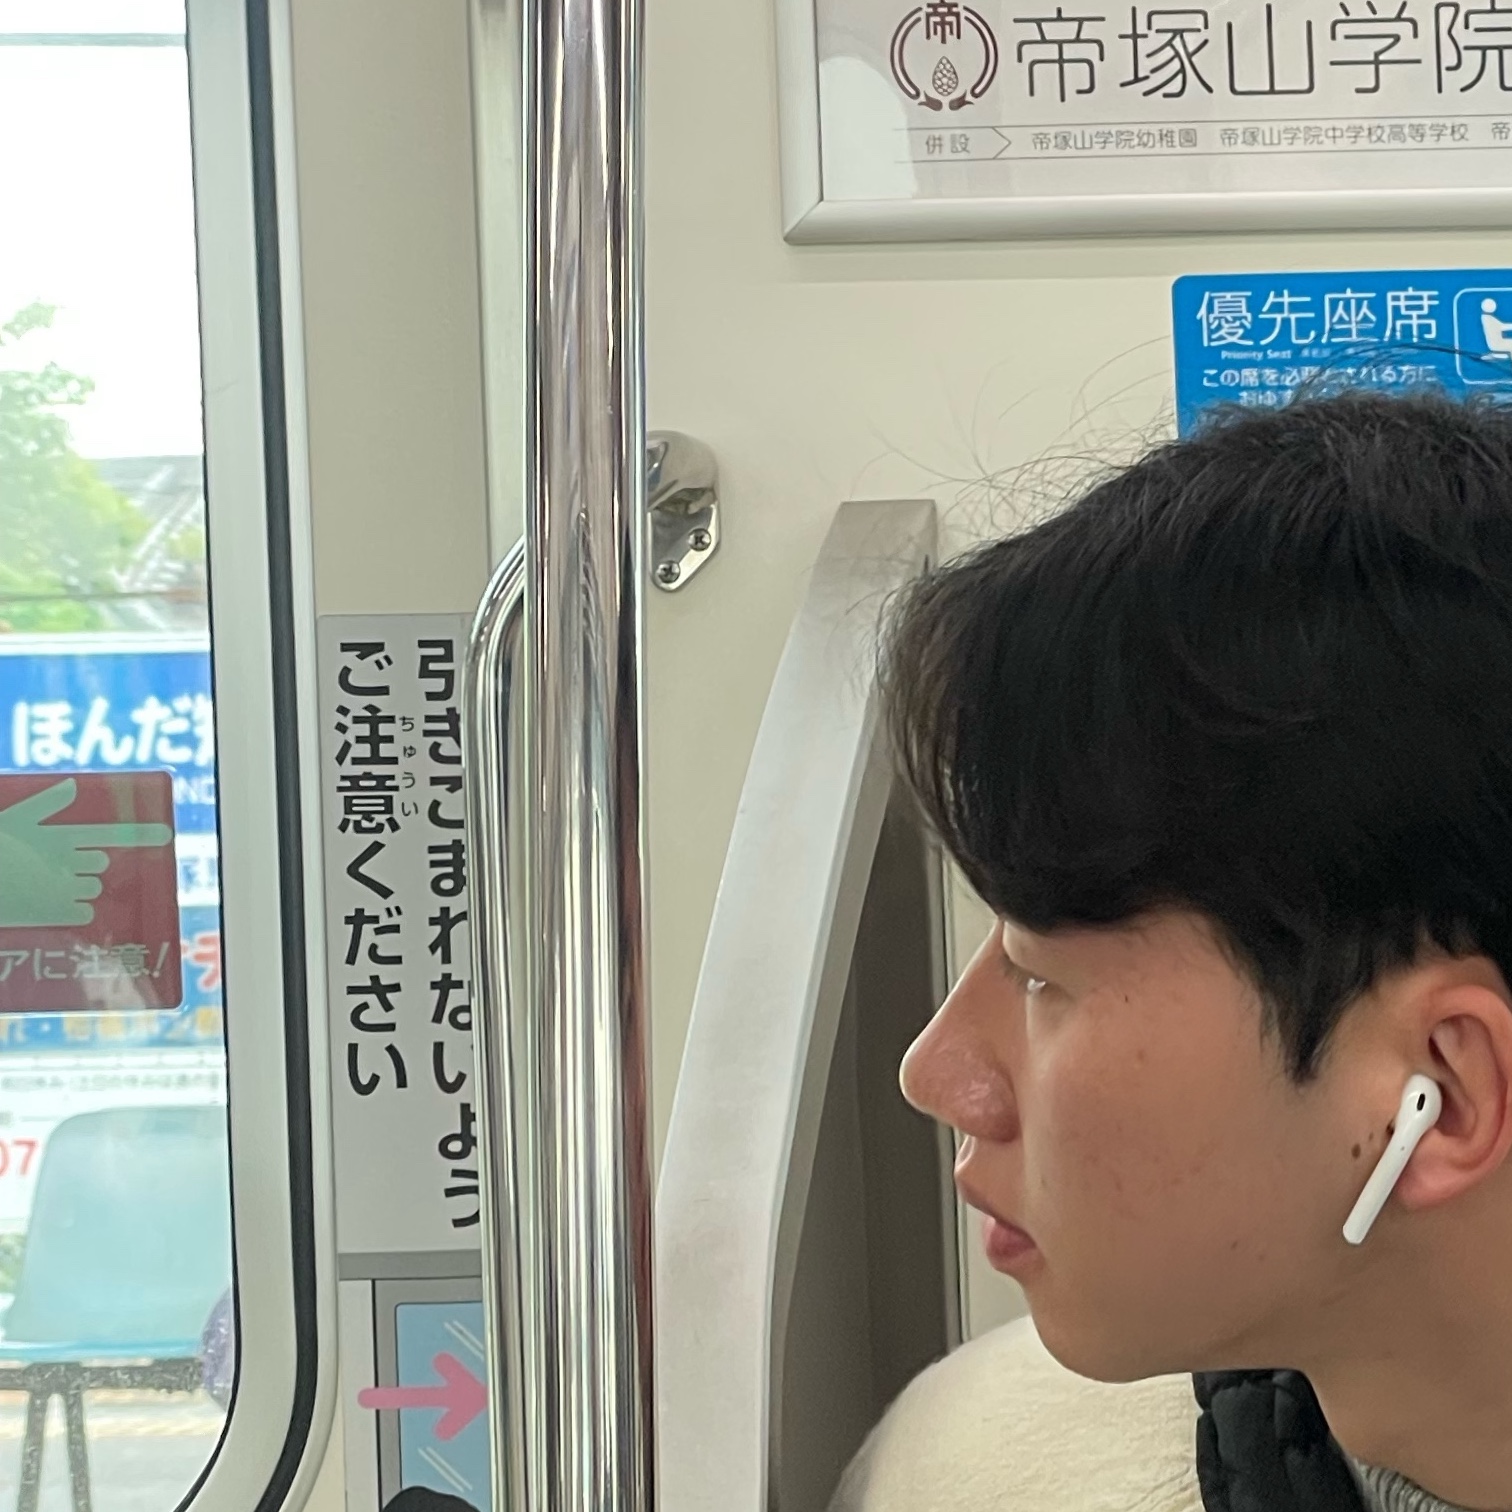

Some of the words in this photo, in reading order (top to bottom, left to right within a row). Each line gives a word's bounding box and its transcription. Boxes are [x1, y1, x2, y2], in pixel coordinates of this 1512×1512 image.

[1031, 128, 1198, 152] 帝塚山学院幼稚園
[1219, 122, 1470, 148] 帝塚山学院中学校高等学校
[1196, 286, 1440, 347] 優先座席
[1220, 349, 1264, 362] Priority
[1266, 348, 1293, 360] Seat
[334, 640, 409, 1097] ご注意ください
